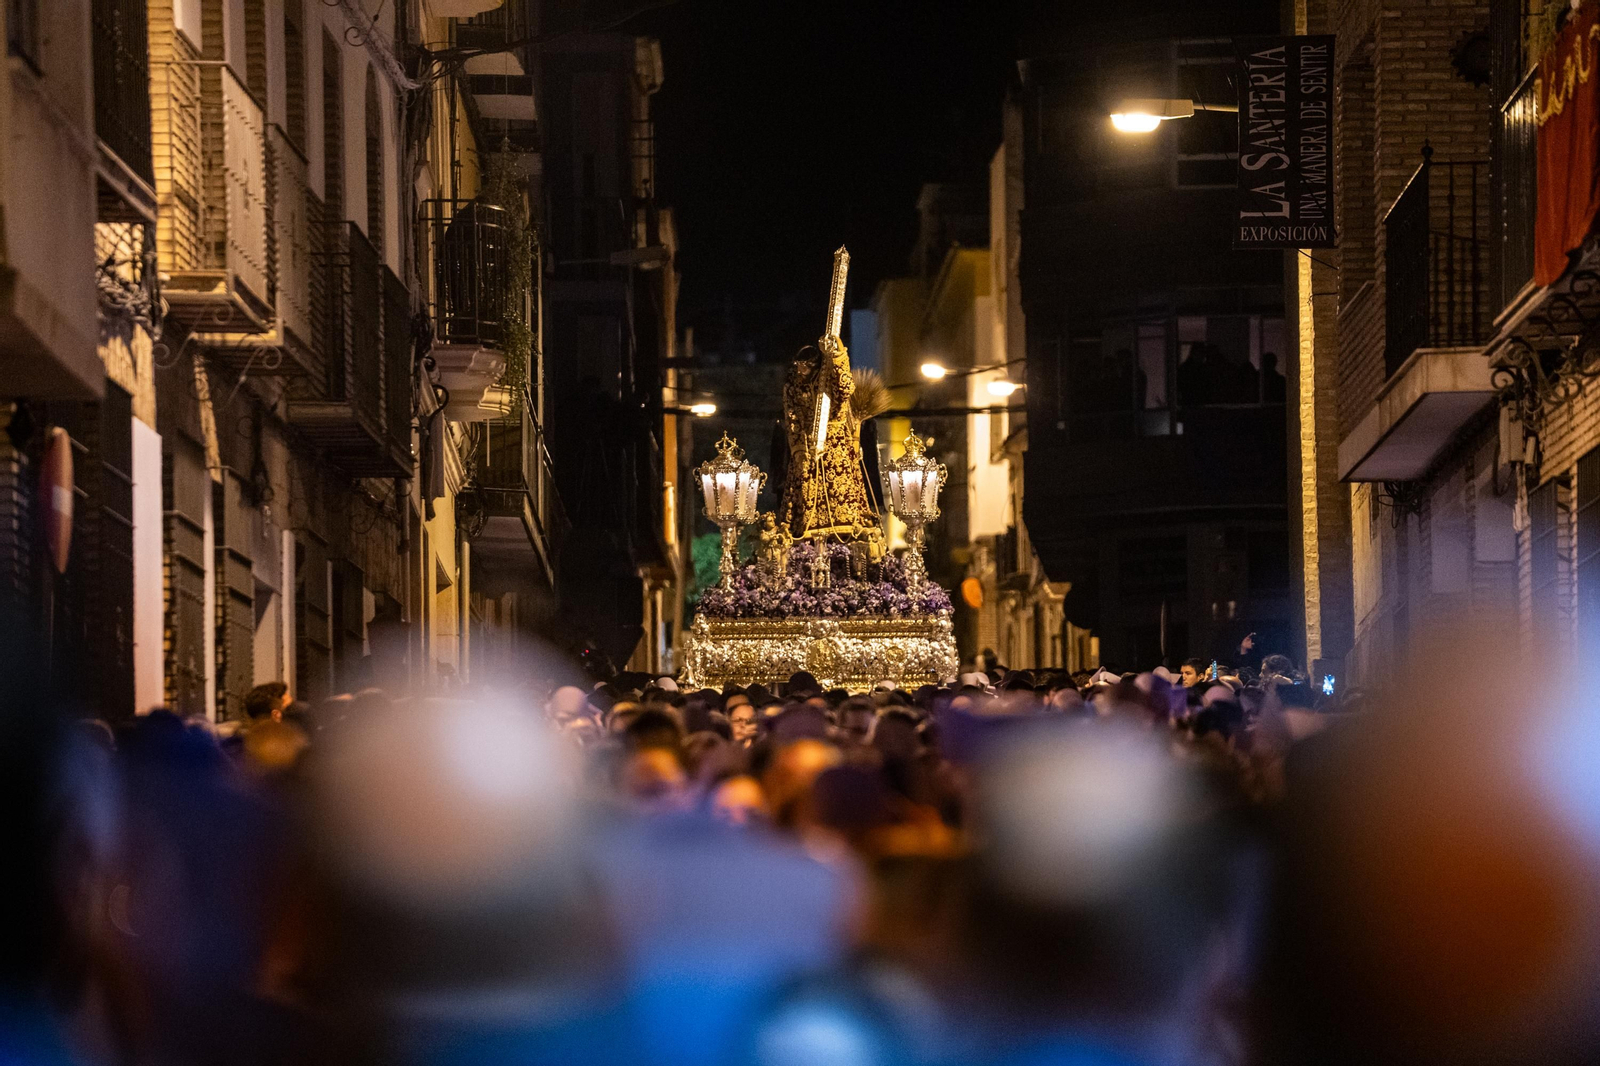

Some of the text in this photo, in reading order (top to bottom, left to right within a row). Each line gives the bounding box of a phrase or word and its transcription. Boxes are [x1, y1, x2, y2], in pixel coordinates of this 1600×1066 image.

[1240, 45, 1290, 219] LA SANTERÍA
[1300, 44, 1327, 219] UNA MANERA DE SENTIR
[1240, 223, 1327, 242] EXPOSICIÓN
